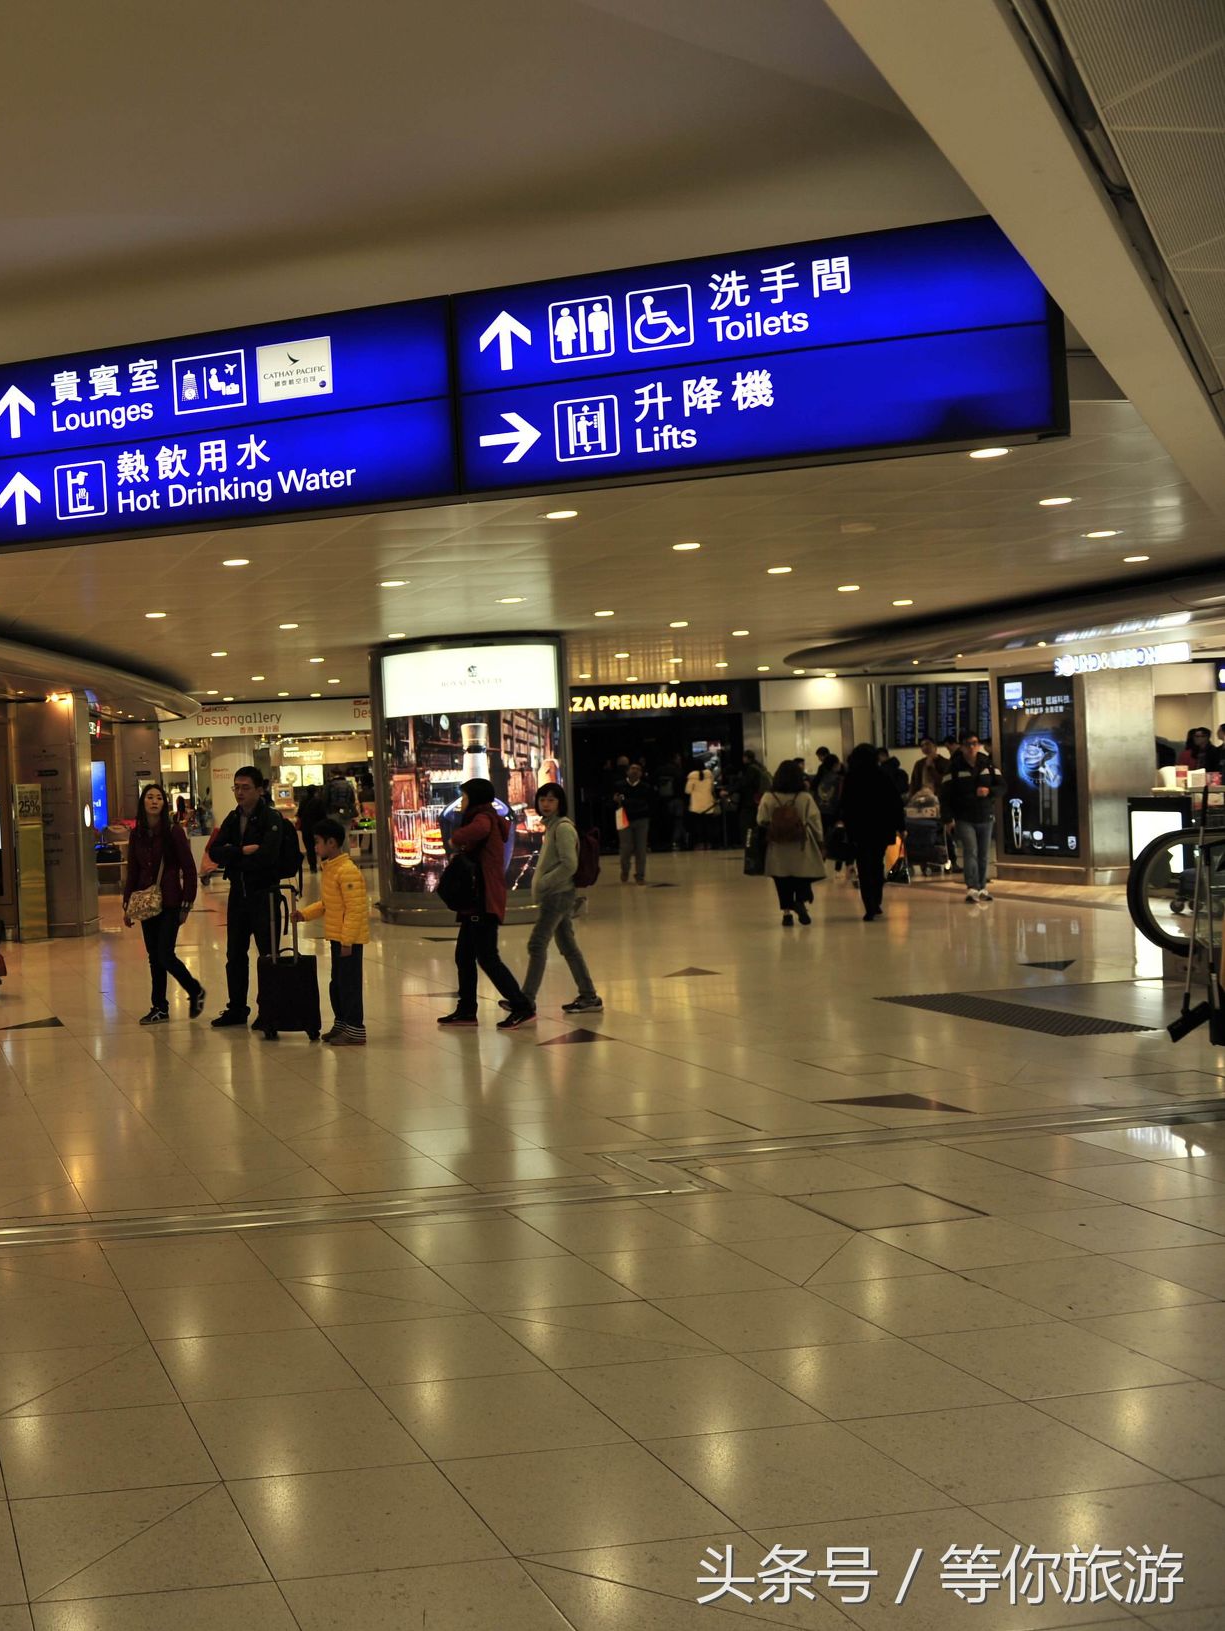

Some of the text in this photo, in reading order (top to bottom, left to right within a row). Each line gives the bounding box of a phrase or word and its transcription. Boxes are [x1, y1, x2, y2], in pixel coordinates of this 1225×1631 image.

[708, 255, 852, 311] 洗手間
[707, 309, 809, 342] Toilets
[50, 358, 160, 407] 貴賓室
[263, 365, 326, 380] CATHAY PACIFIC
[634, 369, 775, 423] 升降機
[51, 402, 154, 433] Lounges
[635, 424, 698, 453] Lifts
[116, 433, 271, 487] 熱飲用水
[117, 467, 357, 514] Hot Drinking Water
[569, 692, 728, 712] ZA PREMIUM LOUNGE
[196, 712, 283, 727] Designgallery
[18, 800, 41, 814] 25%
